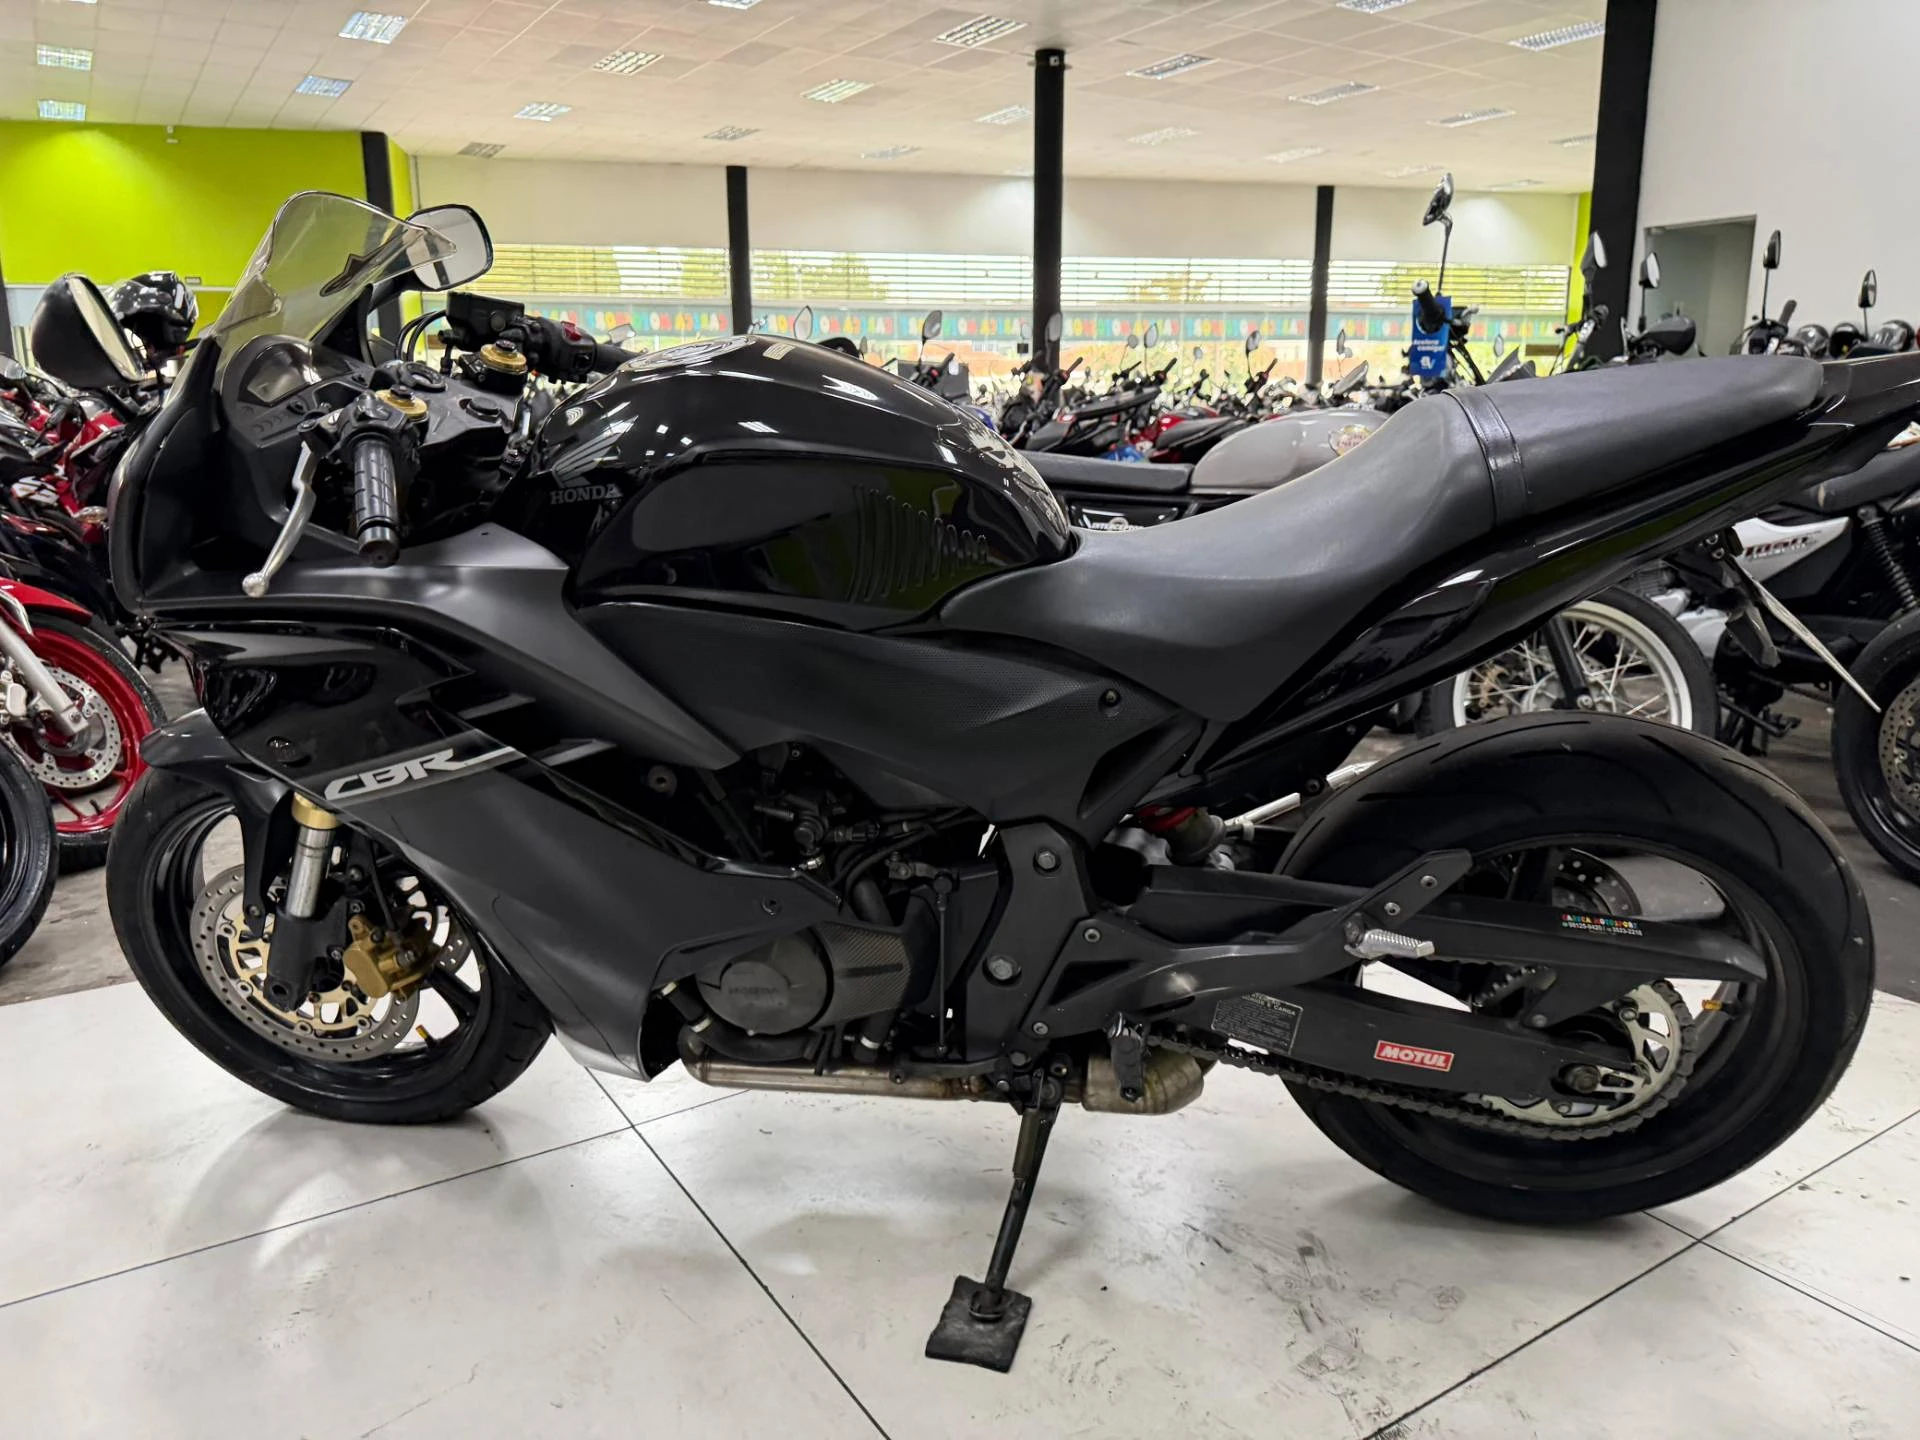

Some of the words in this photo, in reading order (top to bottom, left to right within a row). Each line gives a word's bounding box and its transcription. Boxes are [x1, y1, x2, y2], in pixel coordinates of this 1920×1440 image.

[550, 483, 623, 505] HONDA
[324, 748, 468, 800] CBR
[1381, 1045, 1446, 1067] MOTUL
